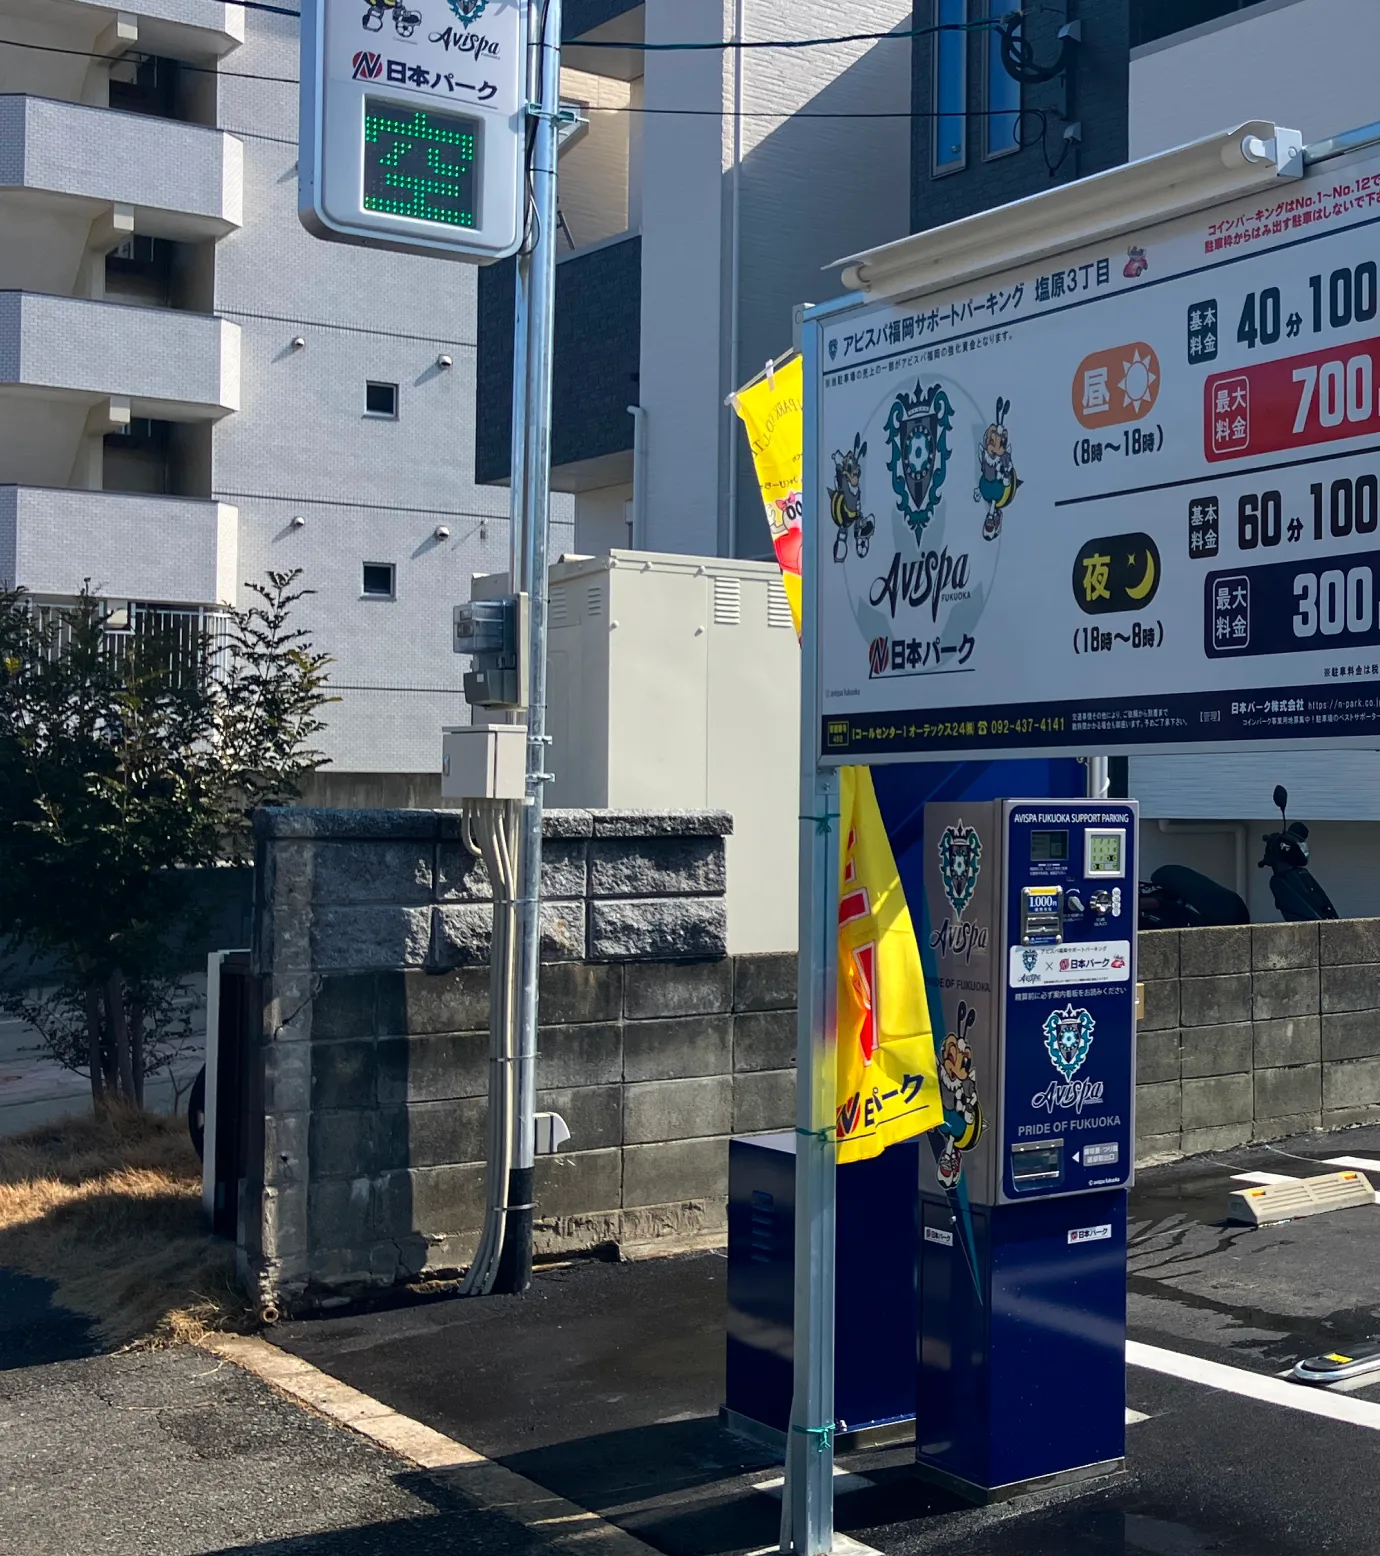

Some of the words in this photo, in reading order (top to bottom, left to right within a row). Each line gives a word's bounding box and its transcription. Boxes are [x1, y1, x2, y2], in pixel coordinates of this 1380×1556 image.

[428, 27, 501, 62] Avispa
[386, 59, 498, 101] 日本パーク
[364, 112, 473, 226] 空
[843, 282, 1025, 356] アビスパ福岡サポートパーキング
[1034, 257, 1110, 301] 塩原3丁目
[1189, 306, 1217, 332] 基本
[1189, 332, 1217, 357] 料金
[1082, 366, 1110, 415] 昼
[1215, 386, 1248, 414] 最大
[1215, 416, 1248, 442] 料金
[1190, 504, 1218, 526] 基本
[1190, 528, 1218, 552] 料金
[869, 545, 970, 623] Avispa
[1082, 552, 1111, 602] 夜
[941, 591, 971, 602] FUKUOKA
[1215, 585, 1248, 611] 最大
[1215, 612, 1248, 639] 料金
[891, 633, 976, 671] 日本パーク
[1231, 698, 1305, 715] 日本パーク株式会社
[991, 717, 1065, 734] 092-437-4141
[1014, 814, 1038, 823] AVISPA
[1038, 814, 1071, 823] FUKUOKA
[1071, 814, 1100, 823] SUPPORT
[1101, 814, 1129, 823] PARKING
[1070, 957, 1110, 969] 日本パーク
[1018, 1123, 1051, 1136] PRIDE
[1053, 1121, 1068, 1132] OF
[1070, 1116, 1121, 1130] FUKUOKA
[1078, 1228, 1109, 1239] 日本パーク
